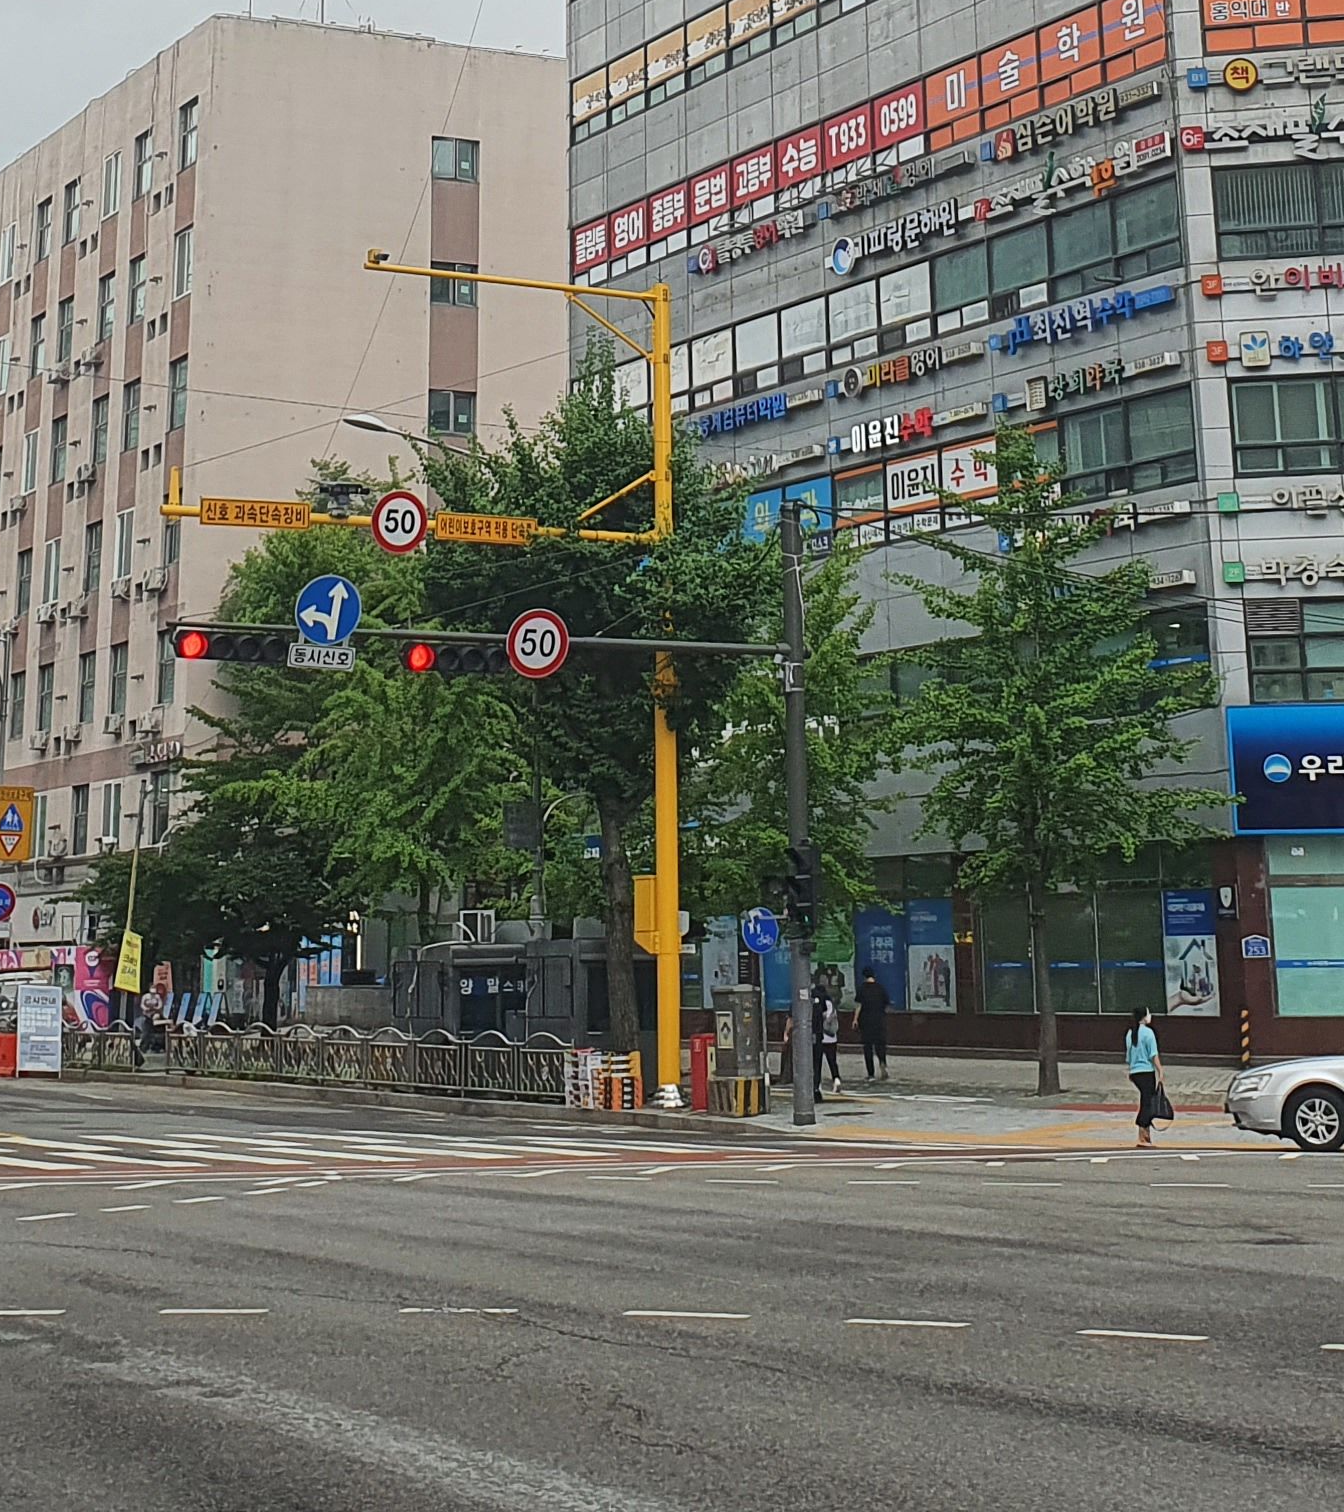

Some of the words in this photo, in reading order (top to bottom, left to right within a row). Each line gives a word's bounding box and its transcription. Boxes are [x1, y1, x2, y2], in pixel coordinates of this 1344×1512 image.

[1016, 87, 1118, 153] 심슨어학원
[1182, 128, 1203, 147] 6F
[613, 206, 644, 249] 영어
[652, 189, 686, 233] 중등부
[694, 170, 728, 216] 문법
[735, 151, 773, 198] 고등부
[781, 136, 818, 178] 수능
[879, 93, 918, 138] 0599
[866, 345, 941, 387] 미라클영어
[851, 406, 934, 454] 이윤진수학
[205, 502, 230, 523] 신호
[234, 503, 307, 528] 과속단속장비
[384, 509, 416, 534] 50
[520, 629, 556, 658] 50
[293, 647, 352, 668] 동시신호
[1247, 945, 1266, 956] 253
